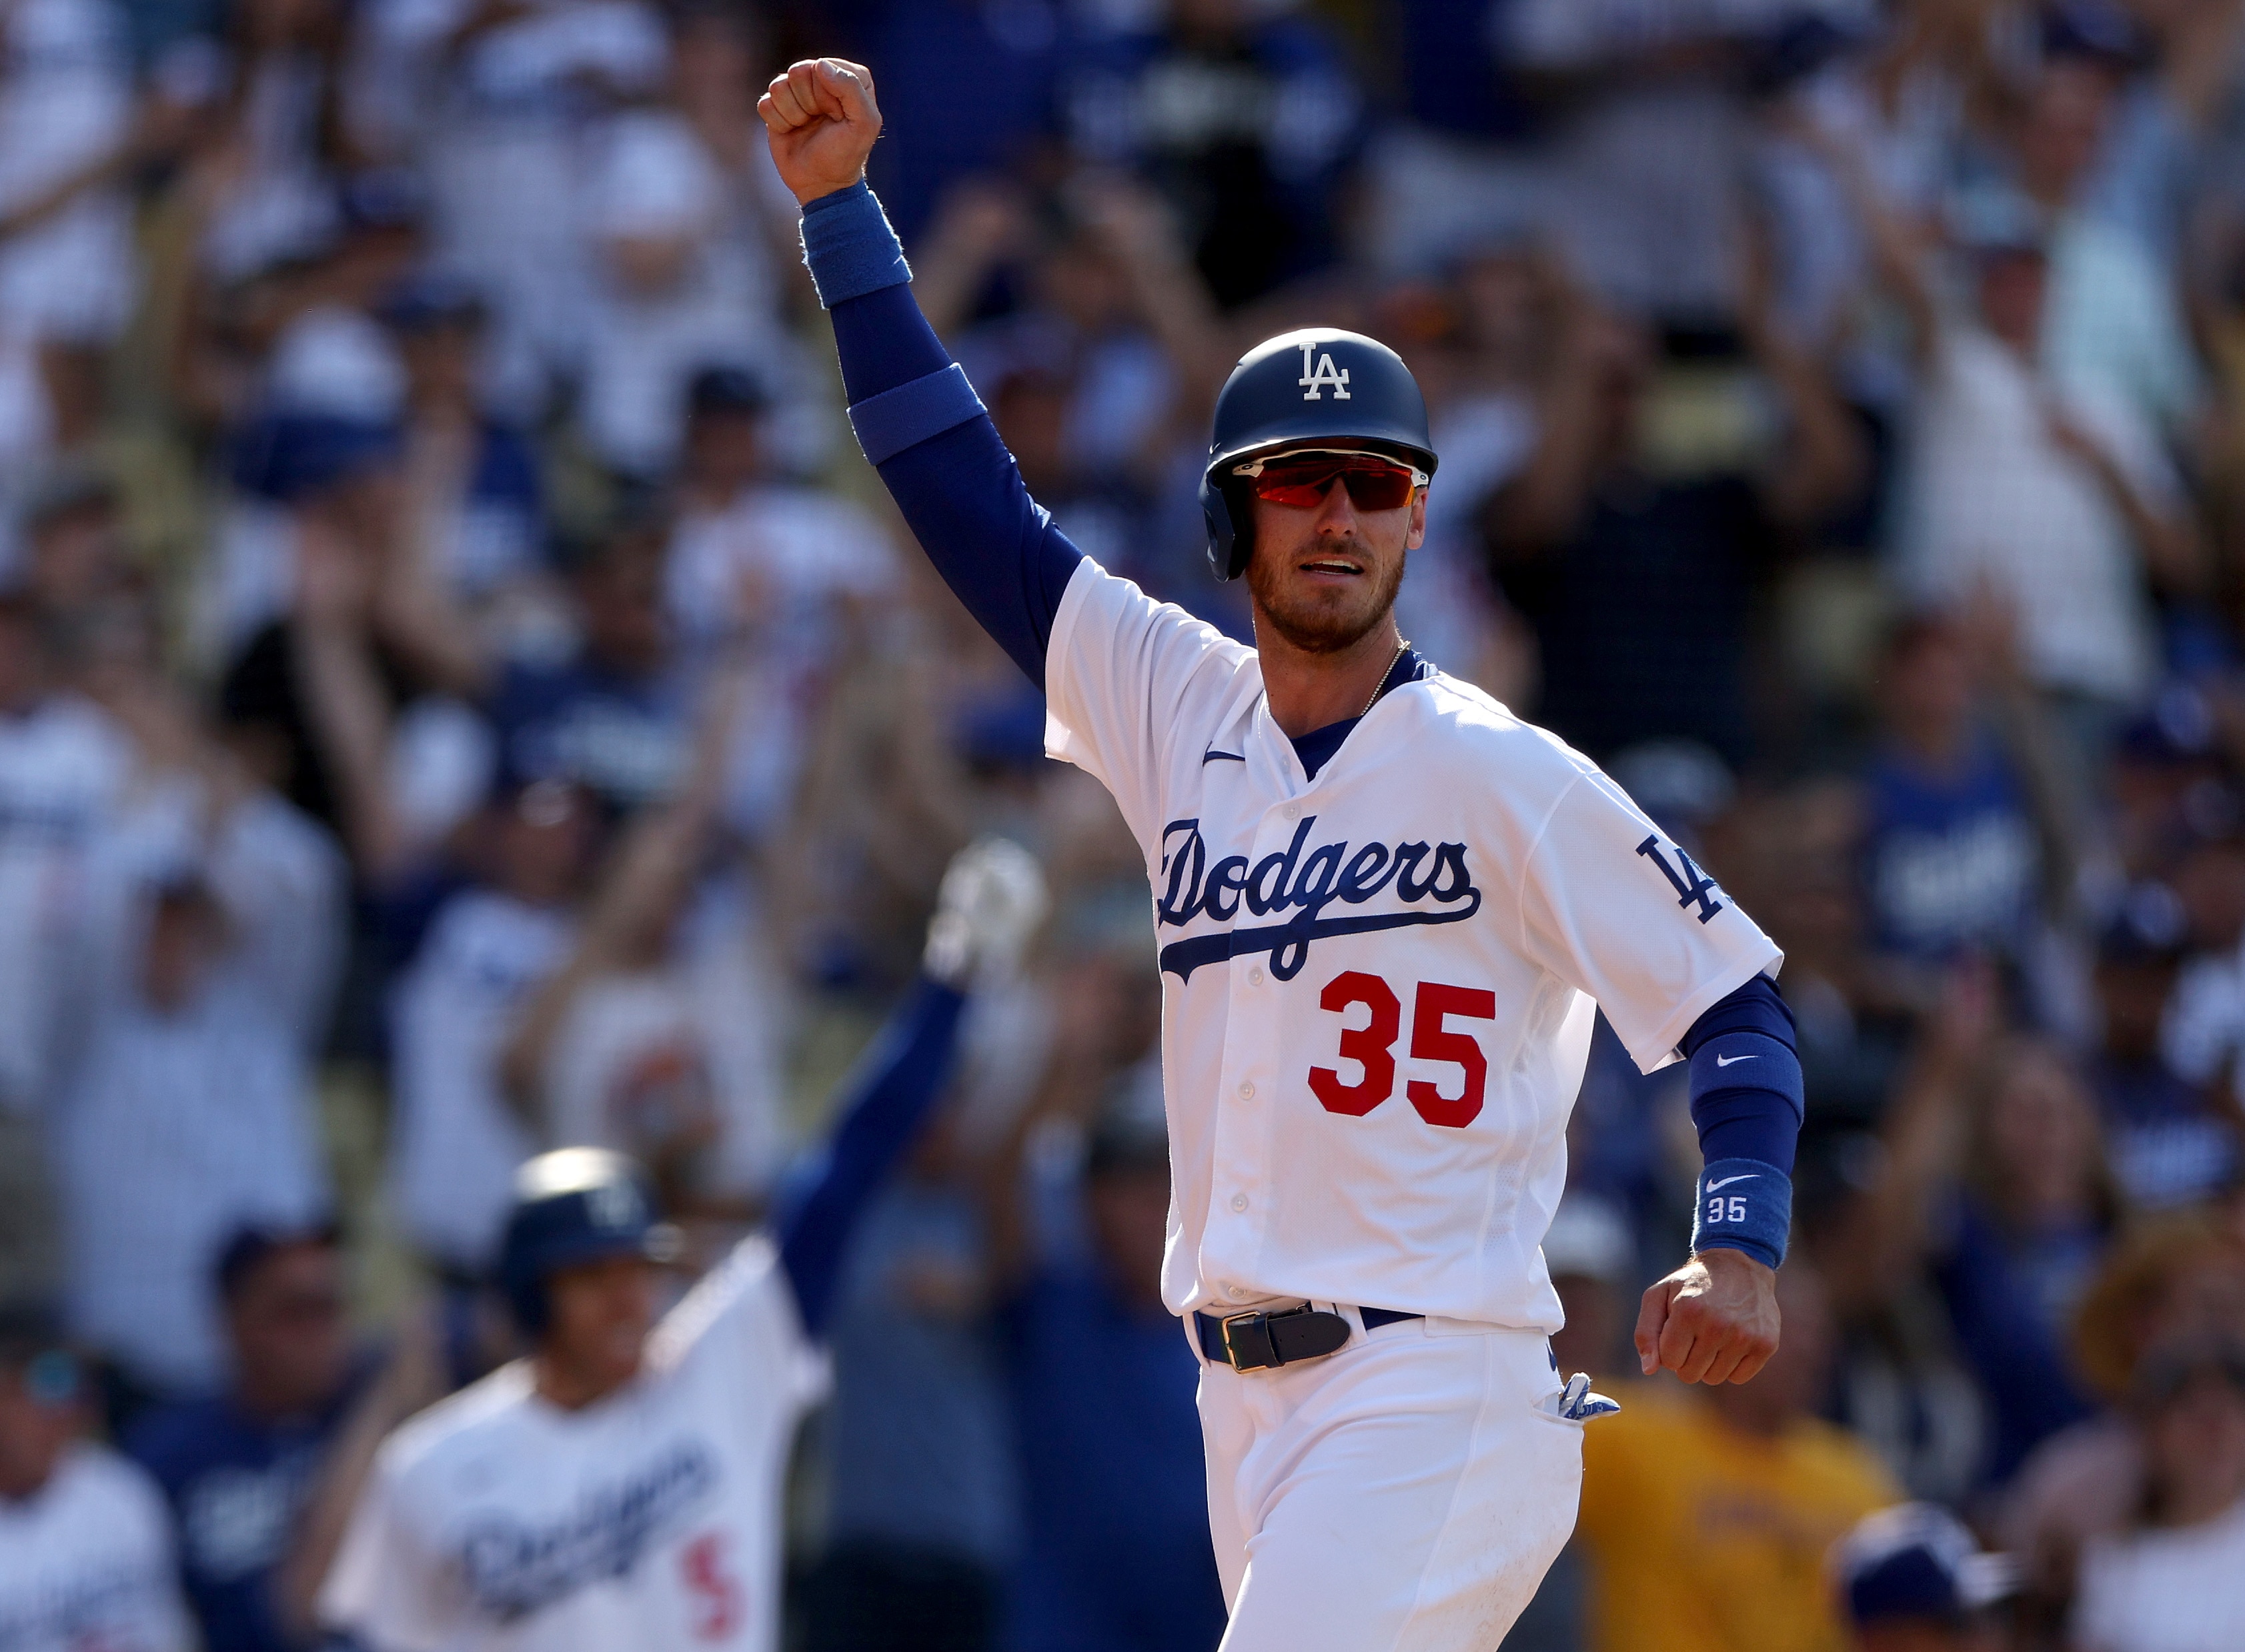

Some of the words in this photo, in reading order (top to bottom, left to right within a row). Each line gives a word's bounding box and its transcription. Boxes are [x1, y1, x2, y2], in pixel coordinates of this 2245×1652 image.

[1299, 341, 1351, 401] LA
[1157, 815, 1481, 982] Dodgers
[1635, 834, 1724, 925] LA
[1308, 970, 1496, 1128] 35
[1707, 1196, 1747, 1224] 35
[675, 1531, 750, 1643] 5
